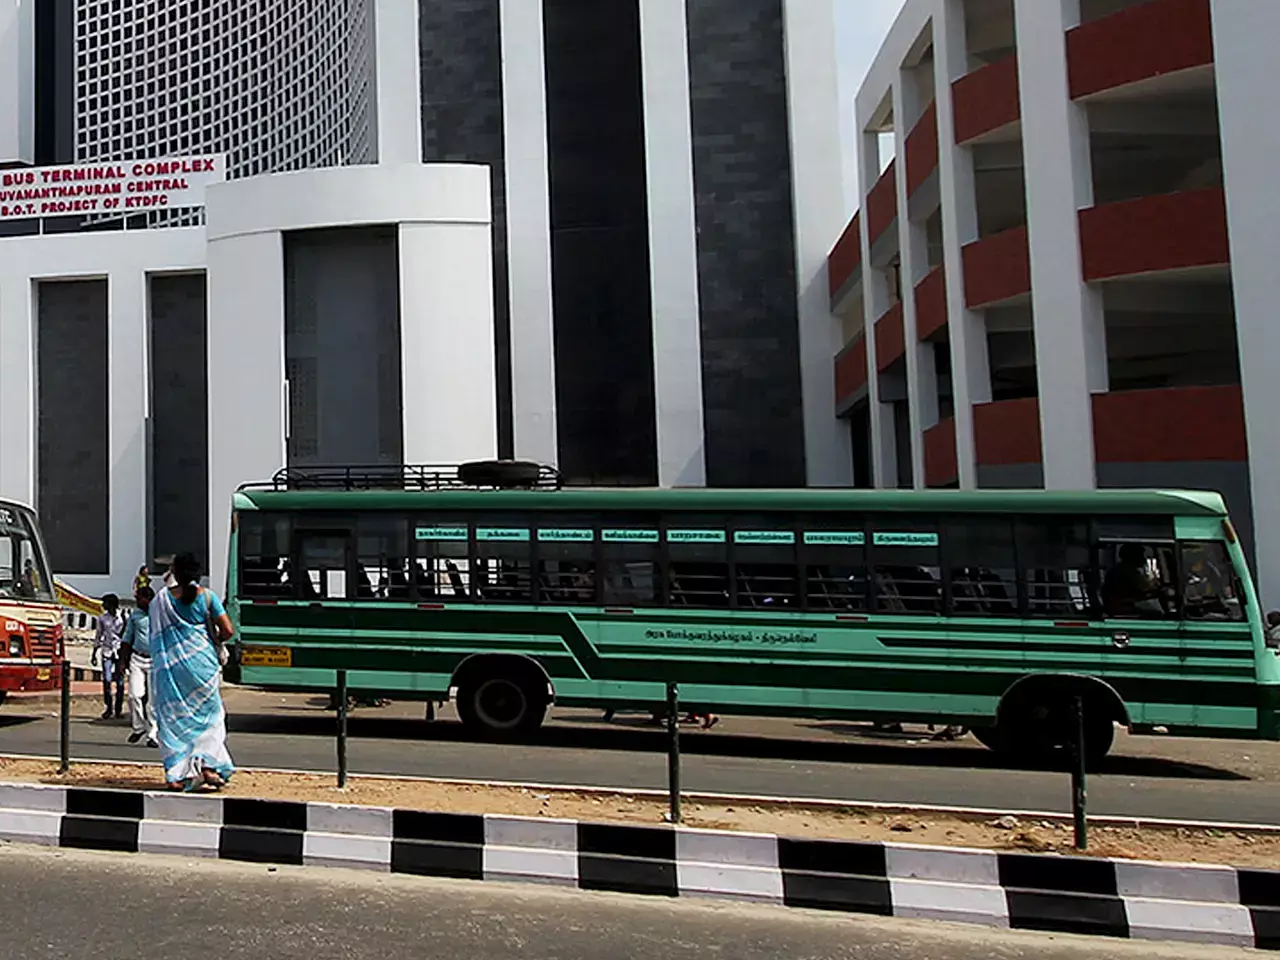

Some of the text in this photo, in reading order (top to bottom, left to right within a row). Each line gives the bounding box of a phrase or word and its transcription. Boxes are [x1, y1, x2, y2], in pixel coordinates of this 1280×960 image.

[2, 172, 35, 186] BUS
[41, 166, 126, 183] TERMINAL
[132, 159, 215, 176] COMPLEX
[126, 178, 189, 193] CENTRAL
[41, 199, 98, 213] PROJECT
[103, 198, 120, 209] OF
[125, 194, 168, 208] KTDFC
